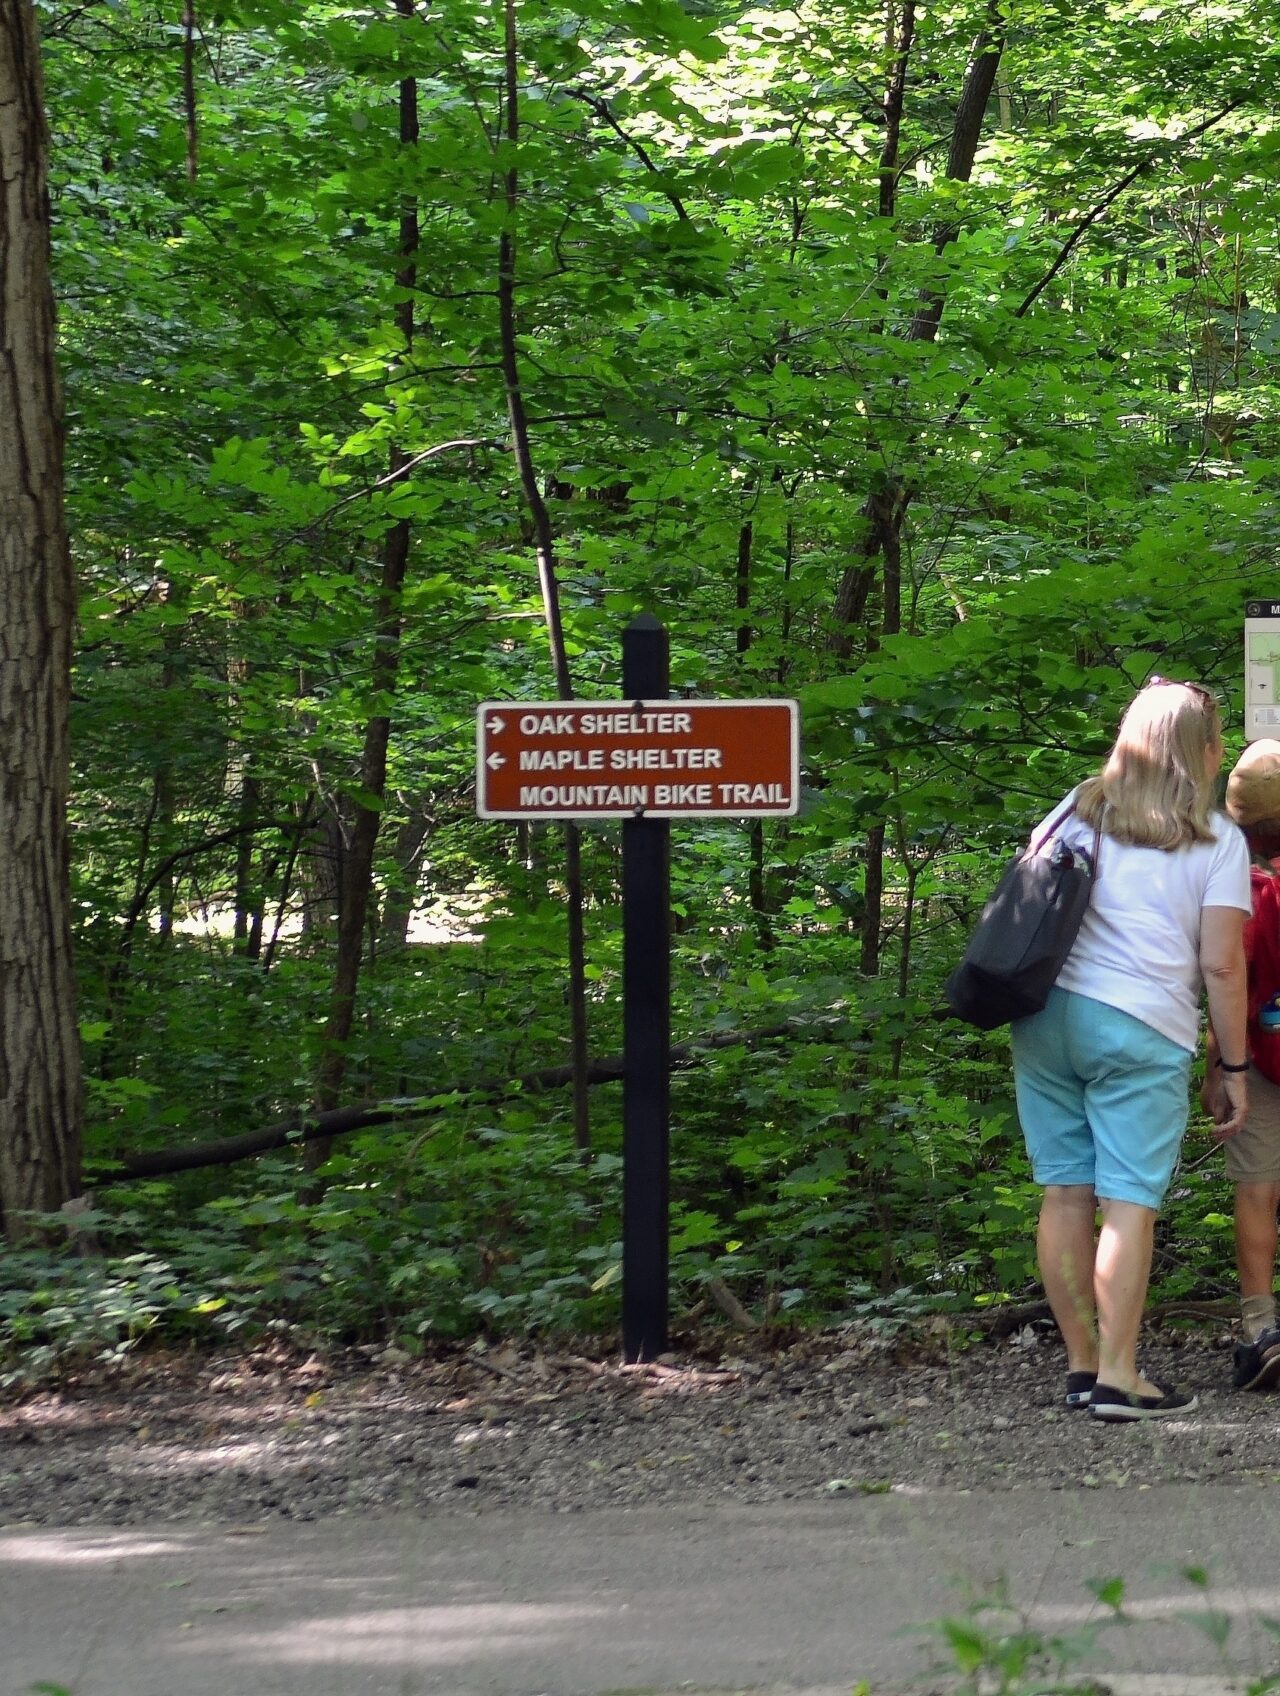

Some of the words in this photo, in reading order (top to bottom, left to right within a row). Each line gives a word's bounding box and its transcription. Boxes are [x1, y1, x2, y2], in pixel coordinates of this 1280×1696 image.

[519, 714, 573, 735] OAK
[580, 712, 691, 734] SHELTER
[519, 749, 604, 770] MAPLE
[610, 748, 722, 770] SHELTER
[519, 785, 648, 806] MOUNTAIN
[654, 784, 712, 804] BIKE
[717, 783, 790, 804] TRAIL
